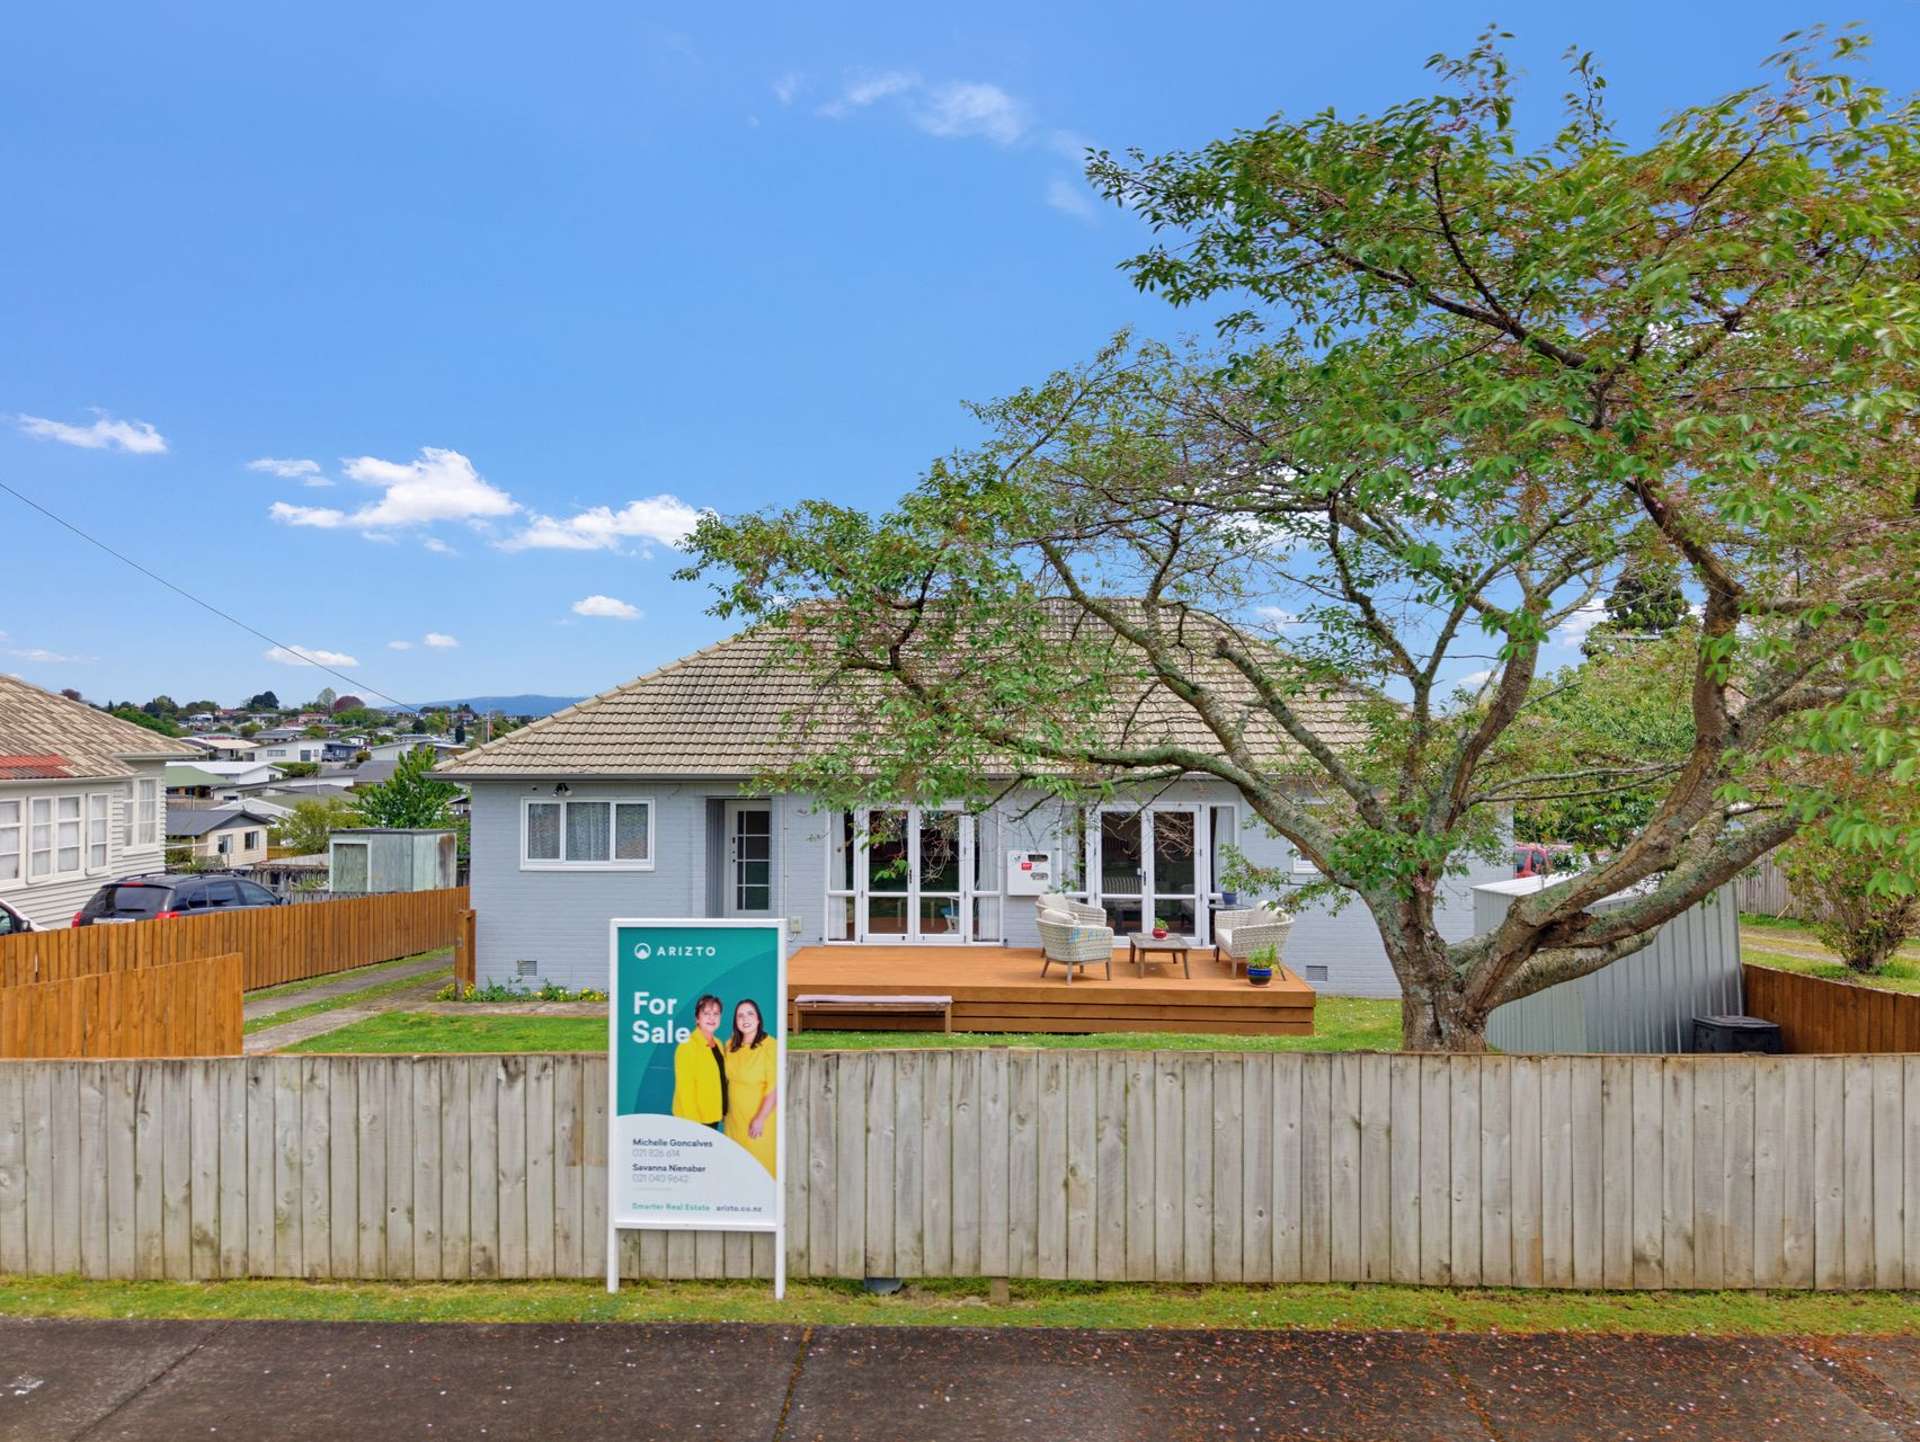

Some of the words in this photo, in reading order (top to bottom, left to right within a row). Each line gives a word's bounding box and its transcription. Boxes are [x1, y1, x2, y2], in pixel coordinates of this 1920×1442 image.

[656, 946, 716, 957] ARIZTO
[633, 991, 678, 1015] For
[632, 1020, 690, 1044] Sale
[632, 1138, 668, 1147] Michelle
[669, 1139, 713, 1148] Goncalves
[632, 1149, 648, 1158] 021
[632, 1163, 667, 1172] Savanna
[668, 1164, 706, 1173] Nienaber
[632, 1174, 648, 1183] 021
[632, 1202, 664, 1211] Smarter
[665, 1203, 684, 1211] Real
[685, 1203, 711, 1212] Estate
